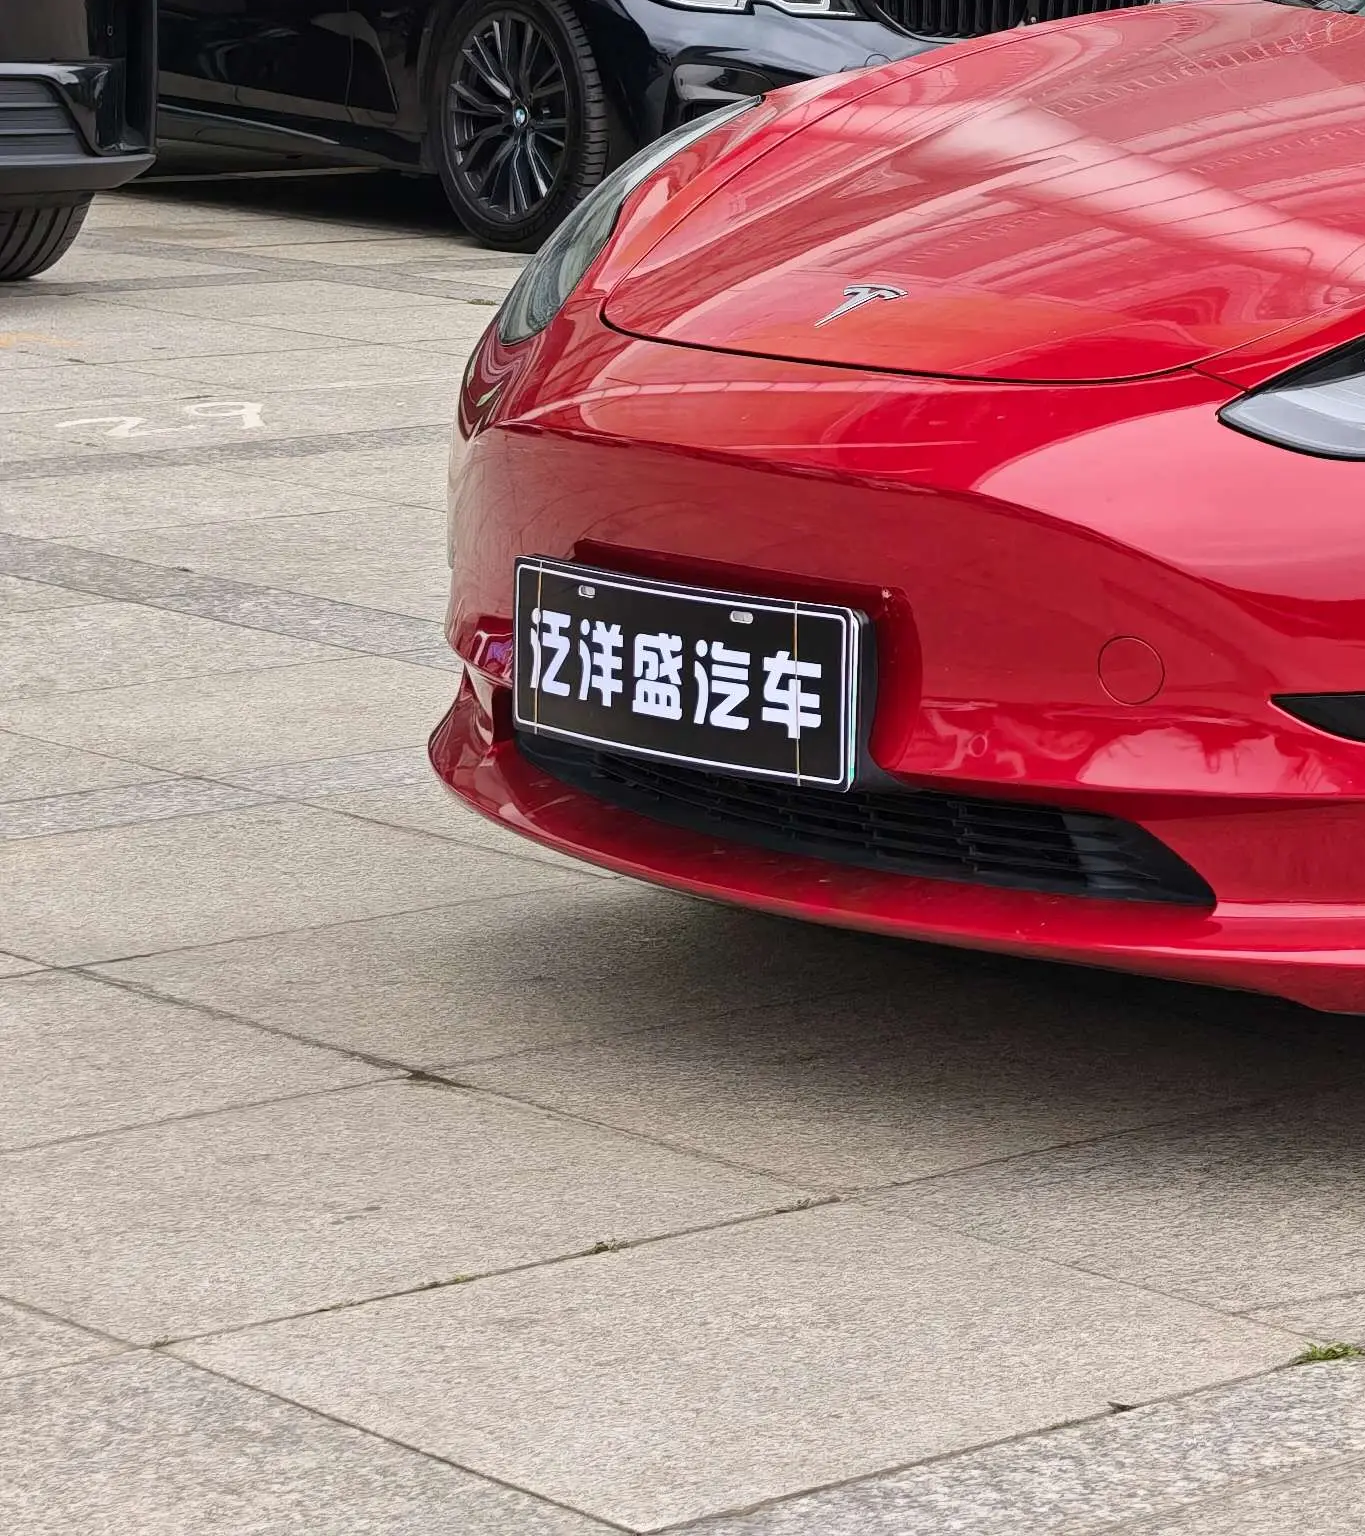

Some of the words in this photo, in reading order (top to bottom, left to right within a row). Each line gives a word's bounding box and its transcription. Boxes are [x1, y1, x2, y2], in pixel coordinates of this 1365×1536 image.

[529, 606, 823, 739] 泛洋盛汽车
